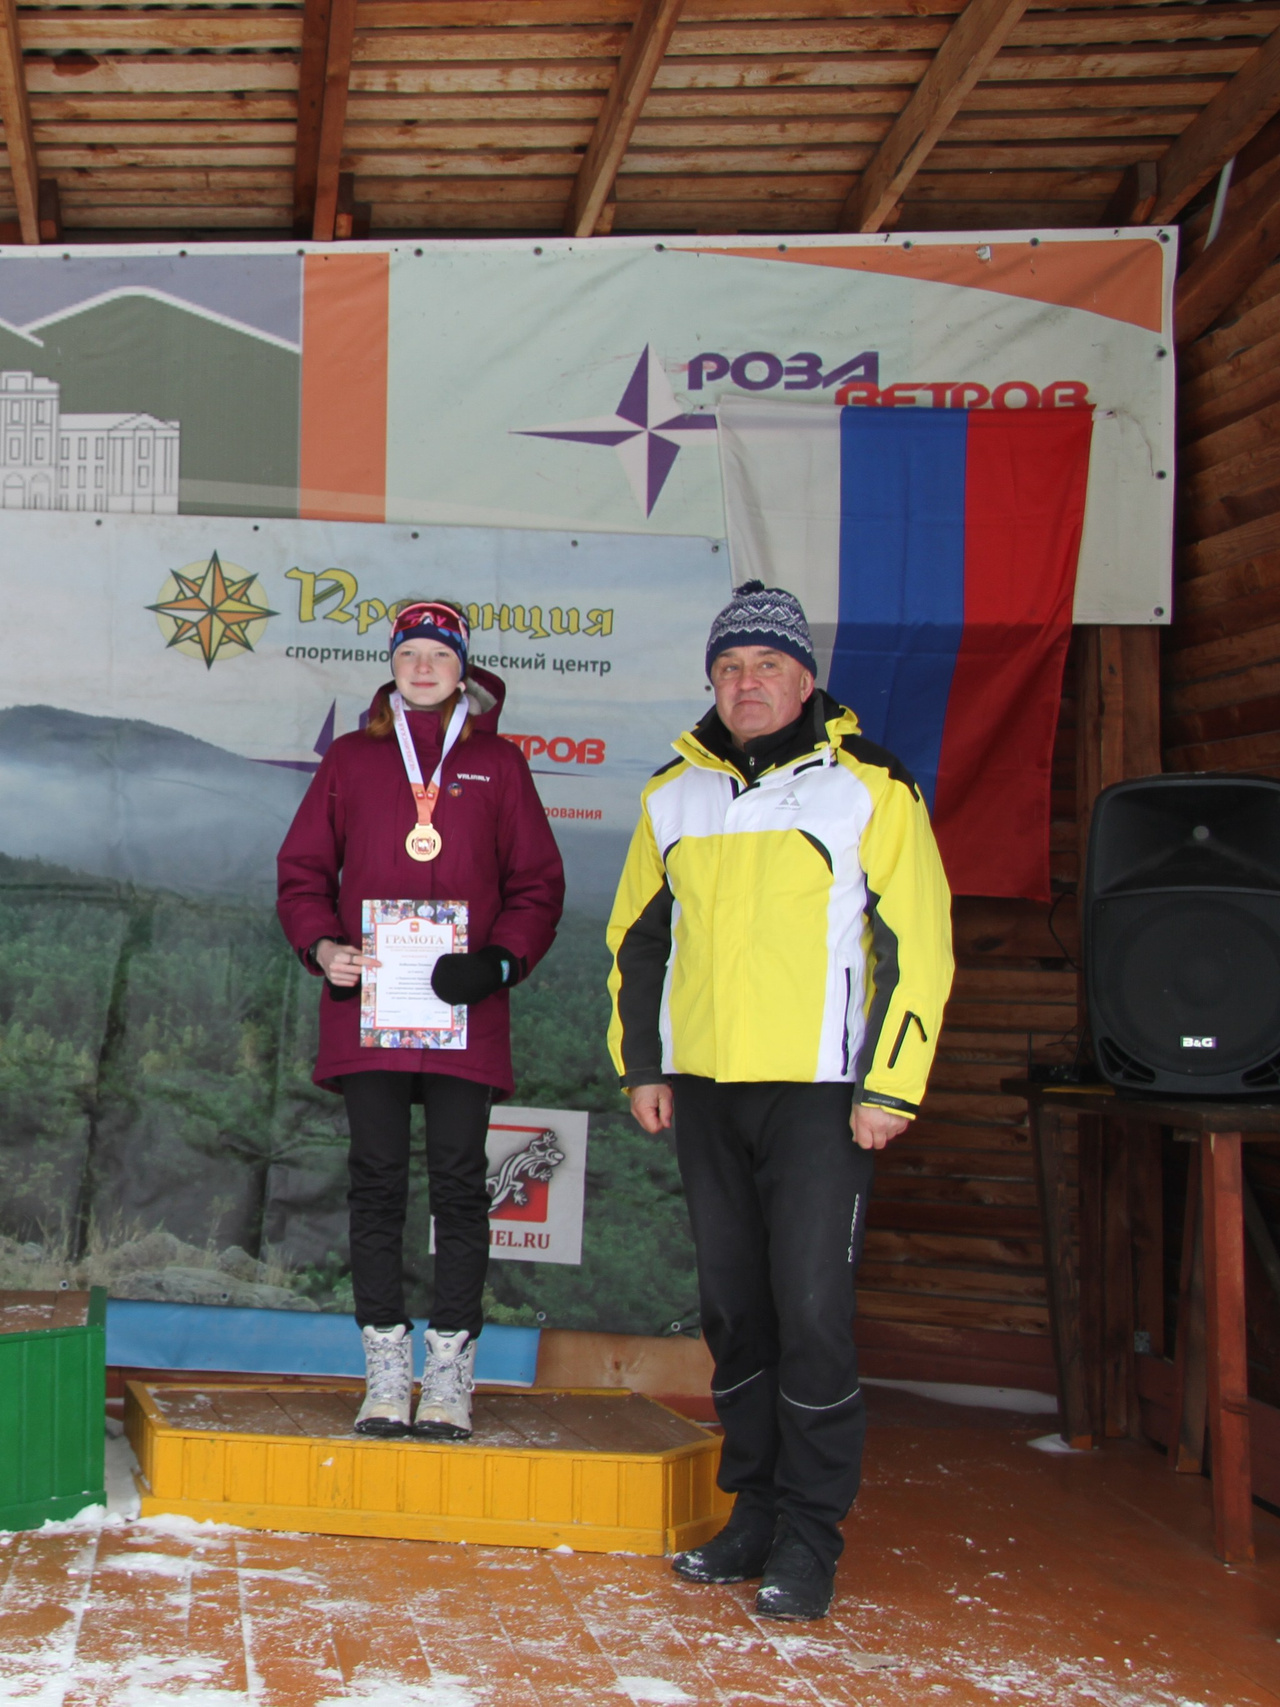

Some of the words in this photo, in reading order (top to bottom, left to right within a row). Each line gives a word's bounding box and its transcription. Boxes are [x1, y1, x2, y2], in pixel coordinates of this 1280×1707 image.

[687, 350, 879, 390] РОЗА
[552, 658, 612, 677] центр
[384, 934, 445, 945] ГРАМОТА
[1182, 1037, 1213, 1048] B&G
[489, 1229, 551, 1250] EL.RU
